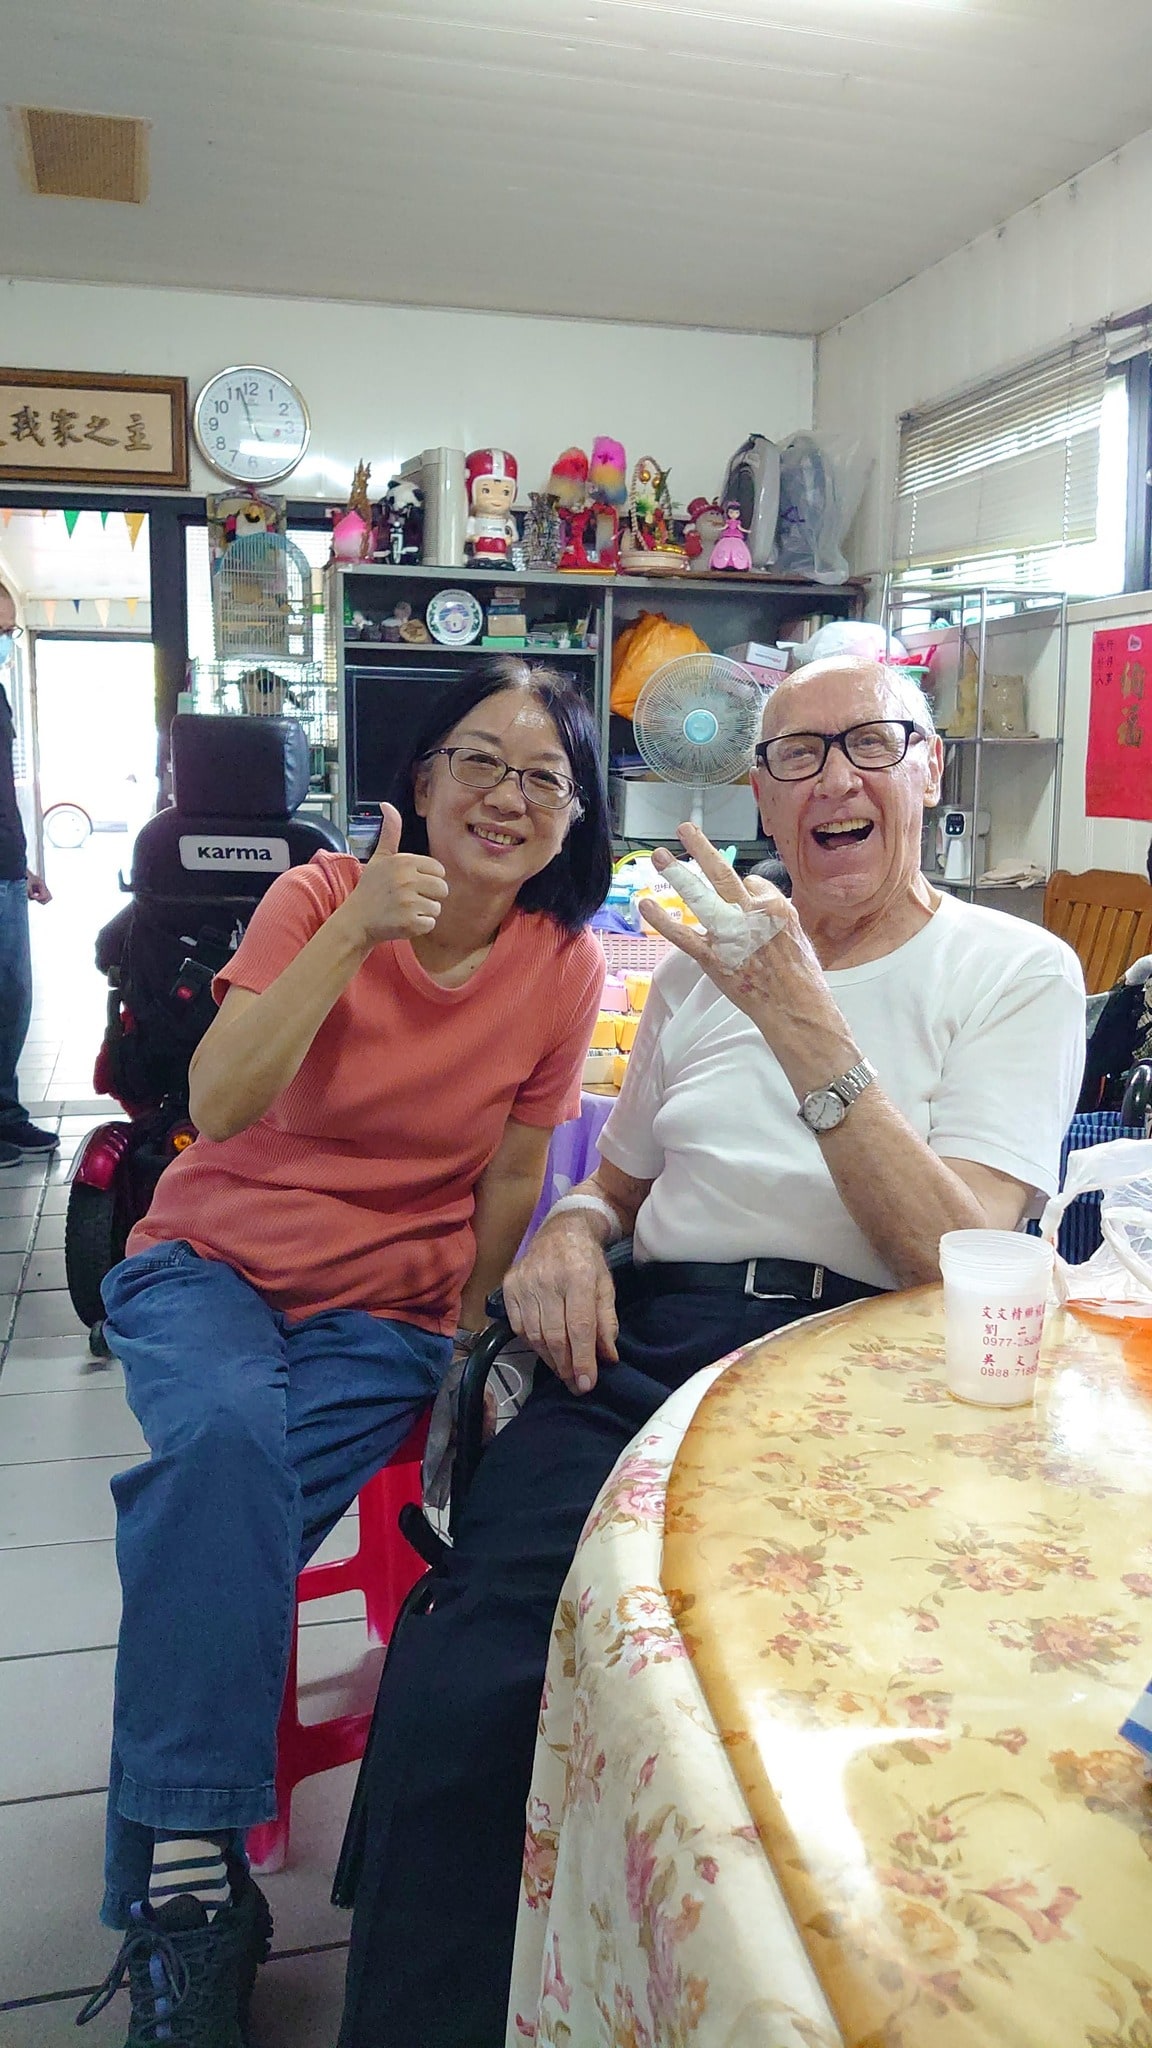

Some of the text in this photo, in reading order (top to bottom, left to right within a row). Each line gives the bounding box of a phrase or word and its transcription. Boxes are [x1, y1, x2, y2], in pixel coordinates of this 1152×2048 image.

[243, 382, 259, 396] 12
[268, 388, 274, 402] 1
[214, 400, 229, 414] 10
[278, 402, 289, 416] 2
[0, 404, 153, 452] 我家之主
[208, 417, 219, 431] 9
[216, 436, 226, 450] 8
[229, 450, 239, 463] 7
[197, 846, 273, 861] karma
